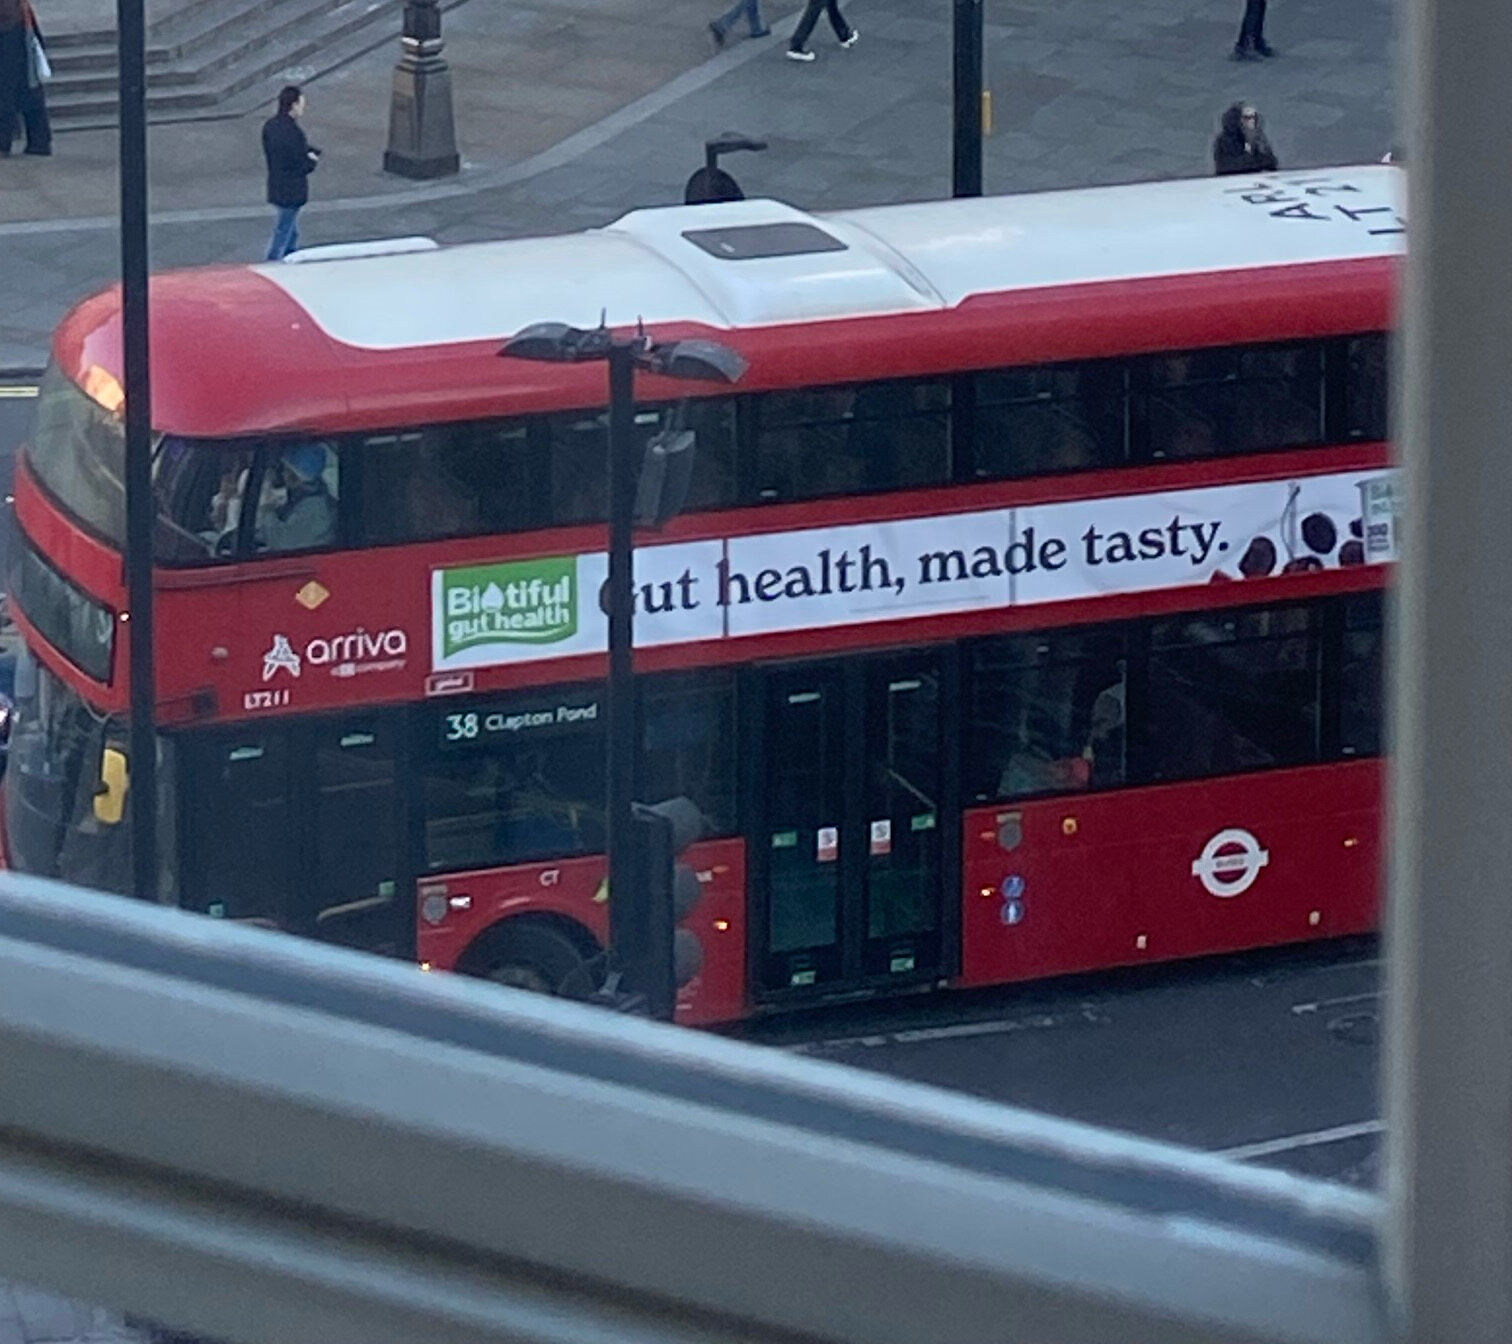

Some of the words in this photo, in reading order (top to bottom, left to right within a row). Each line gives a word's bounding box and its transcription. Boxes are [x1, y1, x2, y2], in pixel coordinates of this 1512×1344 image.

[715, 543, 906, 607] health,
[917, 526, 1068, 585] made
[1081, 515, 1229, 567] tasty.
[448, 612, 490, 643] gut
[494, 604, 571, 631] health
[306, 626, 407, 665] arriva
[244, 688, 290, 710] LT211
[445, 713, 480, 741] 38
[484, 711, 554, 732] Clapton
[556, 703, 598, 723] Pond
